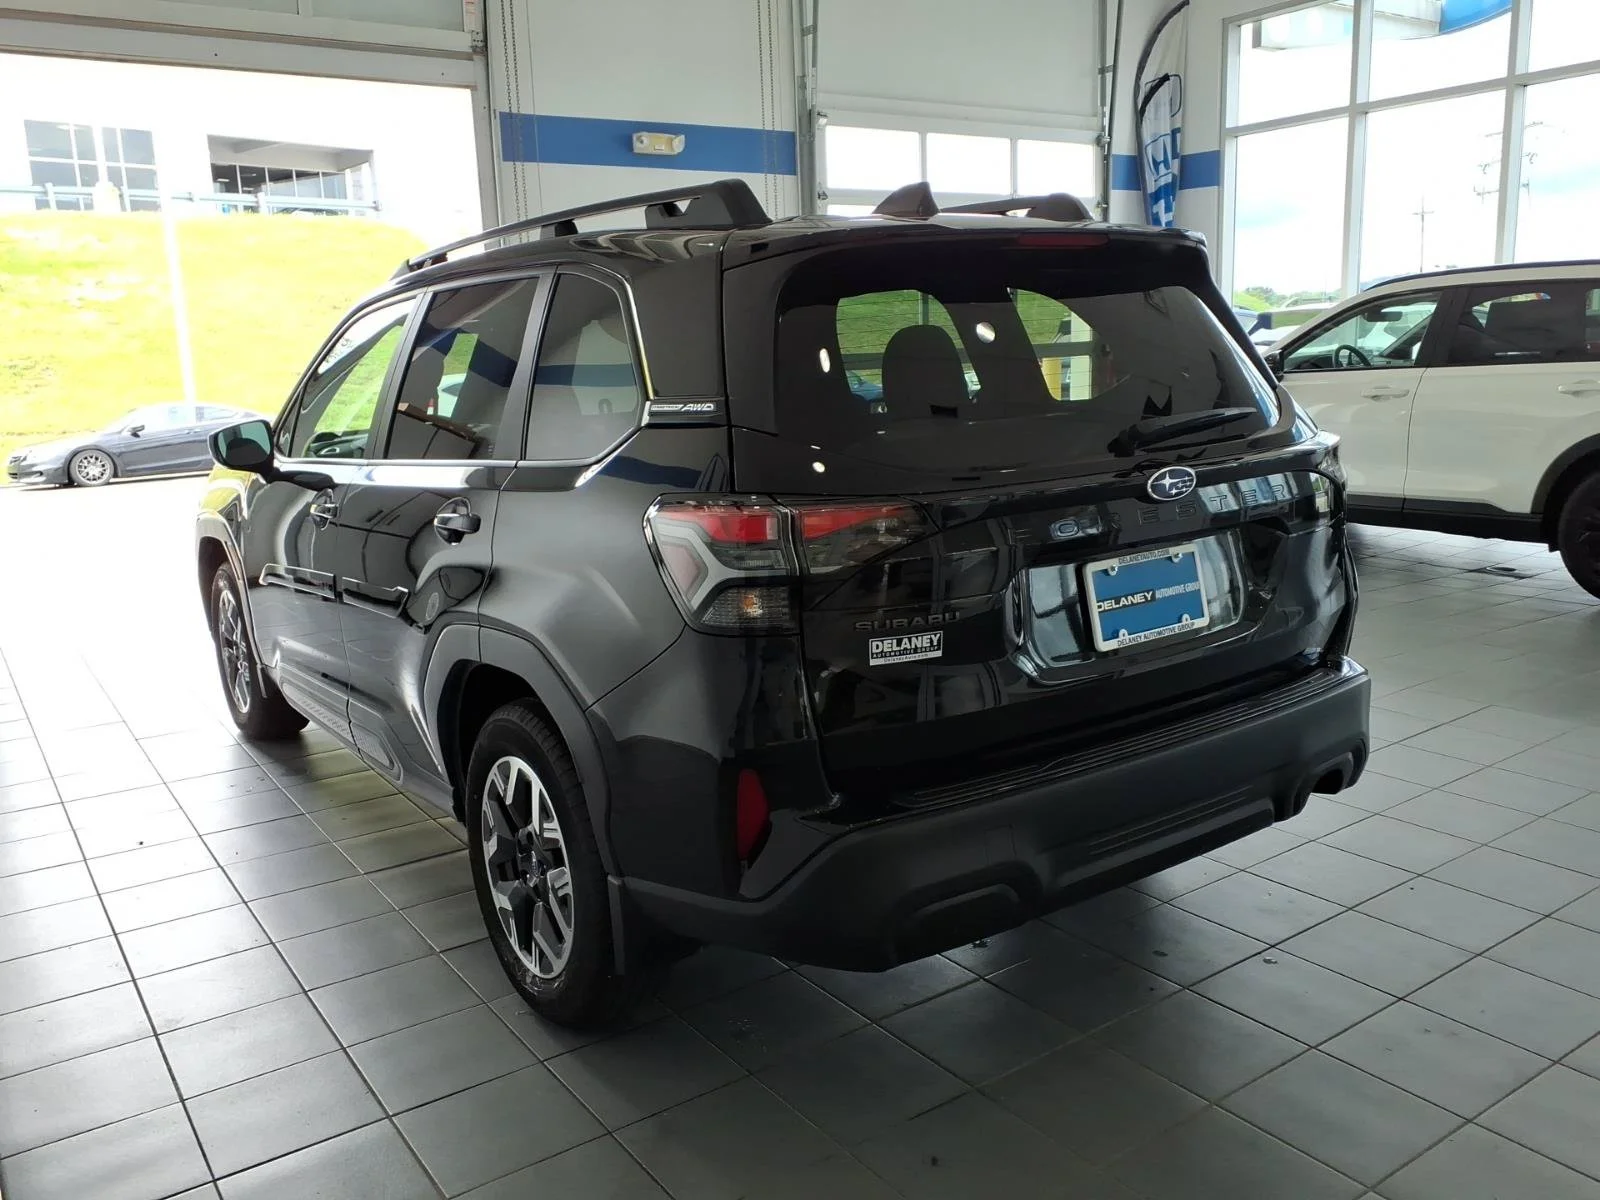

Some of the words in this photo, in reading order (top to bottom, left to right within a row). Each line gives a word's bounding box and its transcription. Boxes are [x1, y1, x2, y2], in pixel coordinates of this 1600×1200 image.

[681, 403, 714, 411] AWD
[1097, 590, 1153, 612] DELANEY
[1155, 584, 1185, 600] AUTOMOTIVE
[855, 611, 960, 632] SUBARU
[872, 633, 941, 653] DELANEY
[1118, 634, 1143, 647] DELANEY
[1144, 625, 1176, 640] AUTOMOTIVE
[1177, 621, 1195, 632] GROUP
[873, 648, 914, 658] AUTOMOTIVE
